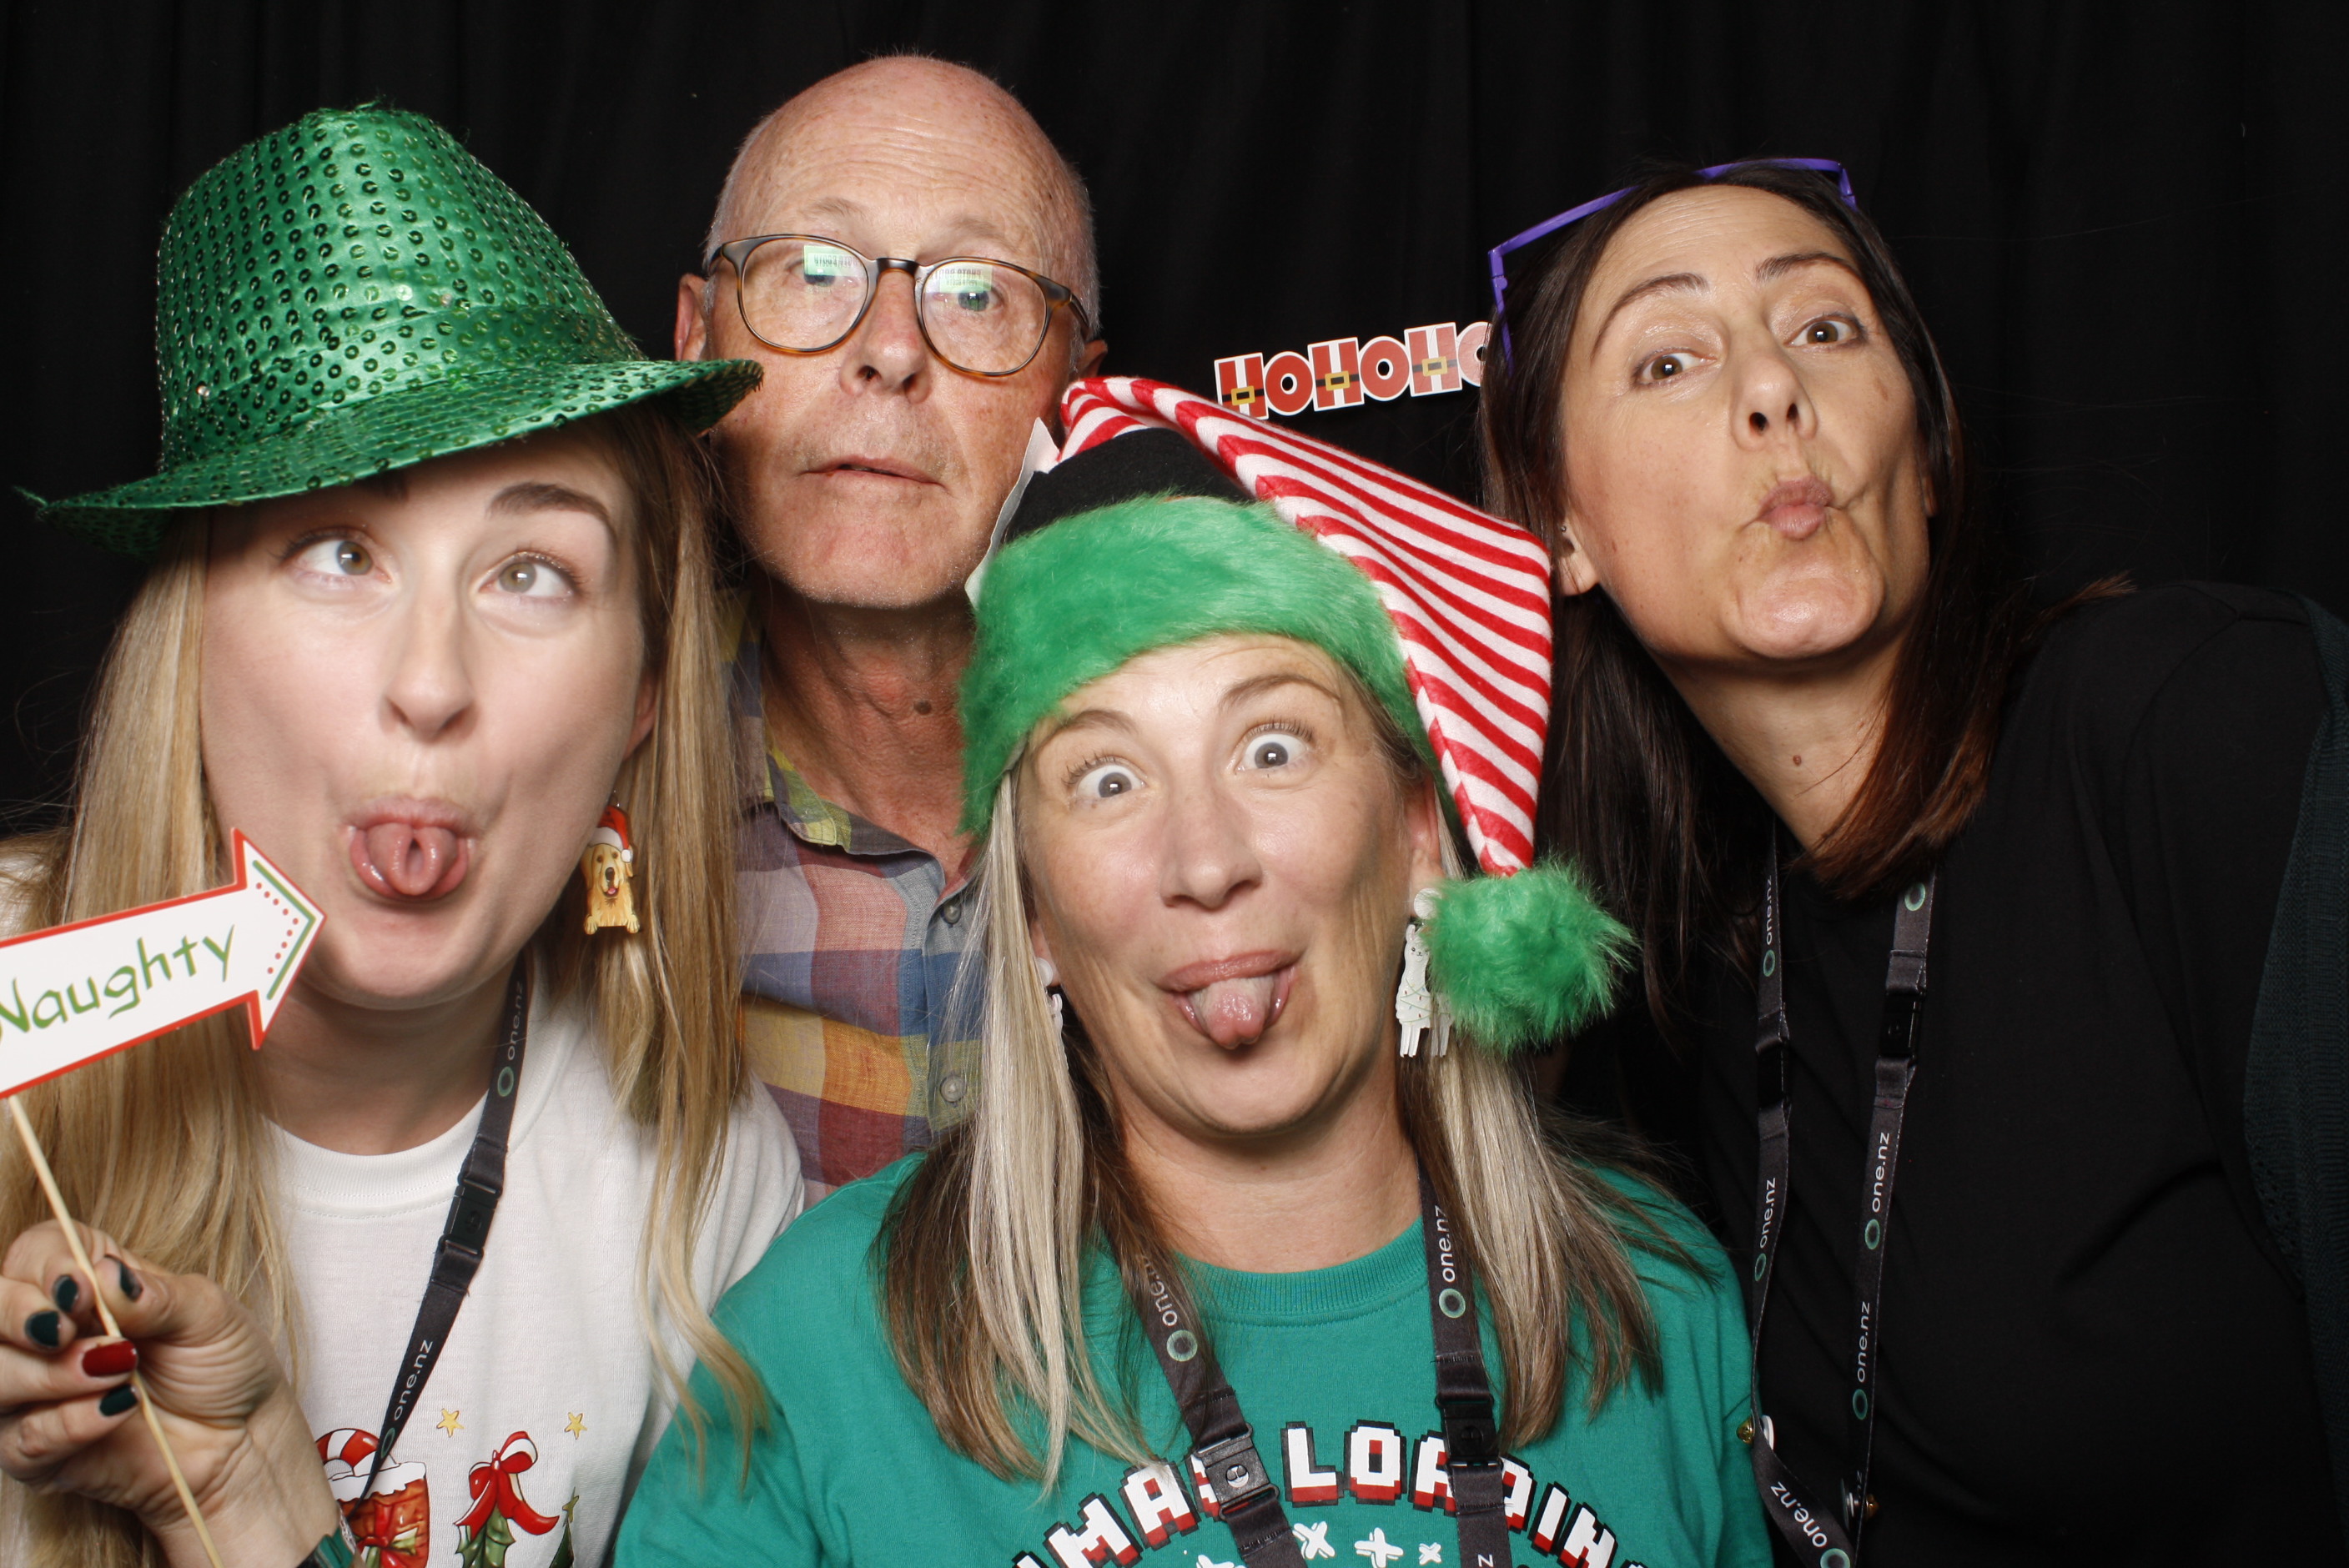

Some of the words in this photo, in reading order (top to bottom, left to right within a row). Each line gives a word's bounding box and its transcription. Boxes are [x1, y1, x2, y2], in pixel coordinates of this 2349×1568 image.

[1765, 876, 1773, 946] one.nz
[507, 980, 523, 1061] one.nz
[1759, 1177, 1776, 1249] one.nz
[1871, 1132, 1889, 1214] one.nz
[394, 1339, 434, 1422] one.nz
[1857, 1301, 1871, 1383] one.nz
[1012, 1453, 1235, 1568] MA
[1280, 1420, 1648, 1568] LOADIN
[1769, 1480, 1828, 1548] one.nz
